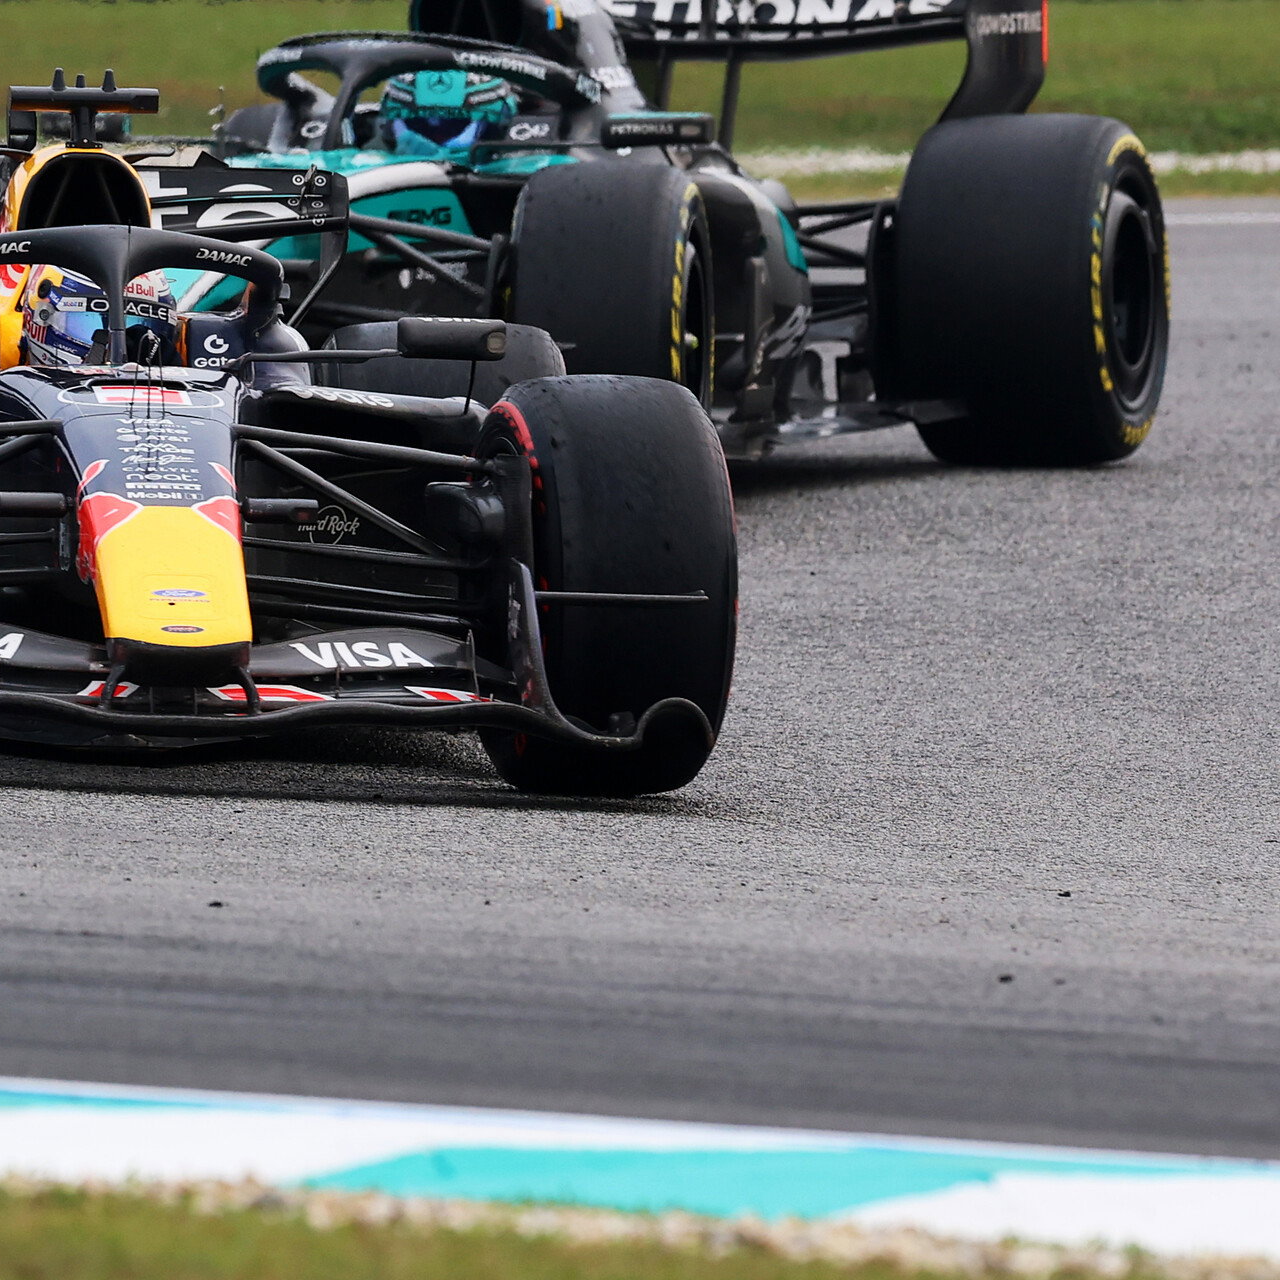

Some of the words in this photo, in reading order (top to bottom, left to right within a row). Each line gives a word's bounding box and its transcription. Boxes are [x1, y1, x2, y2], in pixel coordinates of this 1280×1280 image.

[196, 247, 253, 268] DAMAC
[90, 299, 168, 321] OACLE
[126, 491, 182, 500] Mobil
[327, 515, 361, 535] Rock
[288, 641, 435, 669] VISA
